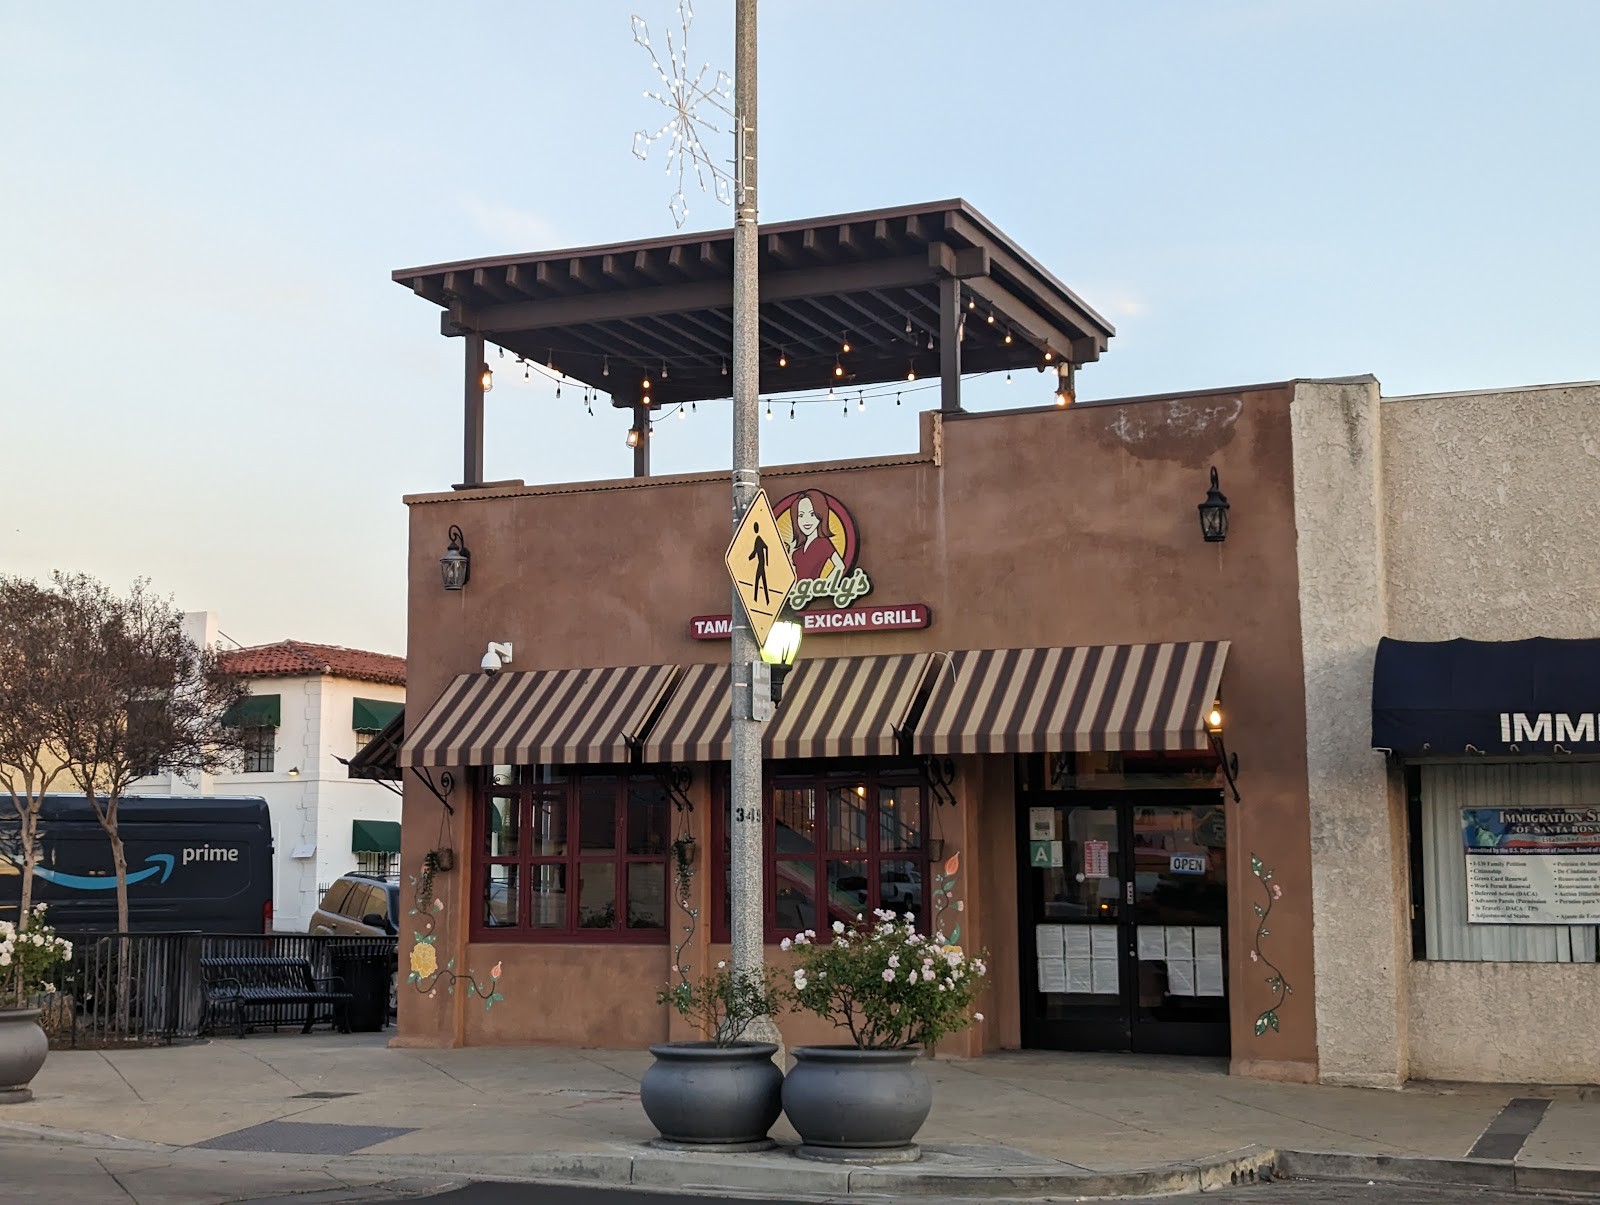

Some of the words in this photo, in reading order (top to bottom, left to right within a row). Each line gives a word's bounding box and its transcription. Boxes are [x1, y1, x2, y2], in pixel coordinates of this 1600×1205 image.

[789, 568, 869, 608] galy's
[804, 613, 866, 628] EXICAN
[871, 610, 921, 625] GRILL
[1500, 713, 1600, 742] IMM
[1500, 811, 1582, 823] IMMIGRATION
[183, 844, 239, 865] prime
[1035, 847, 1048, 861] A
[1174, 858, 1202, 871] OPEN
